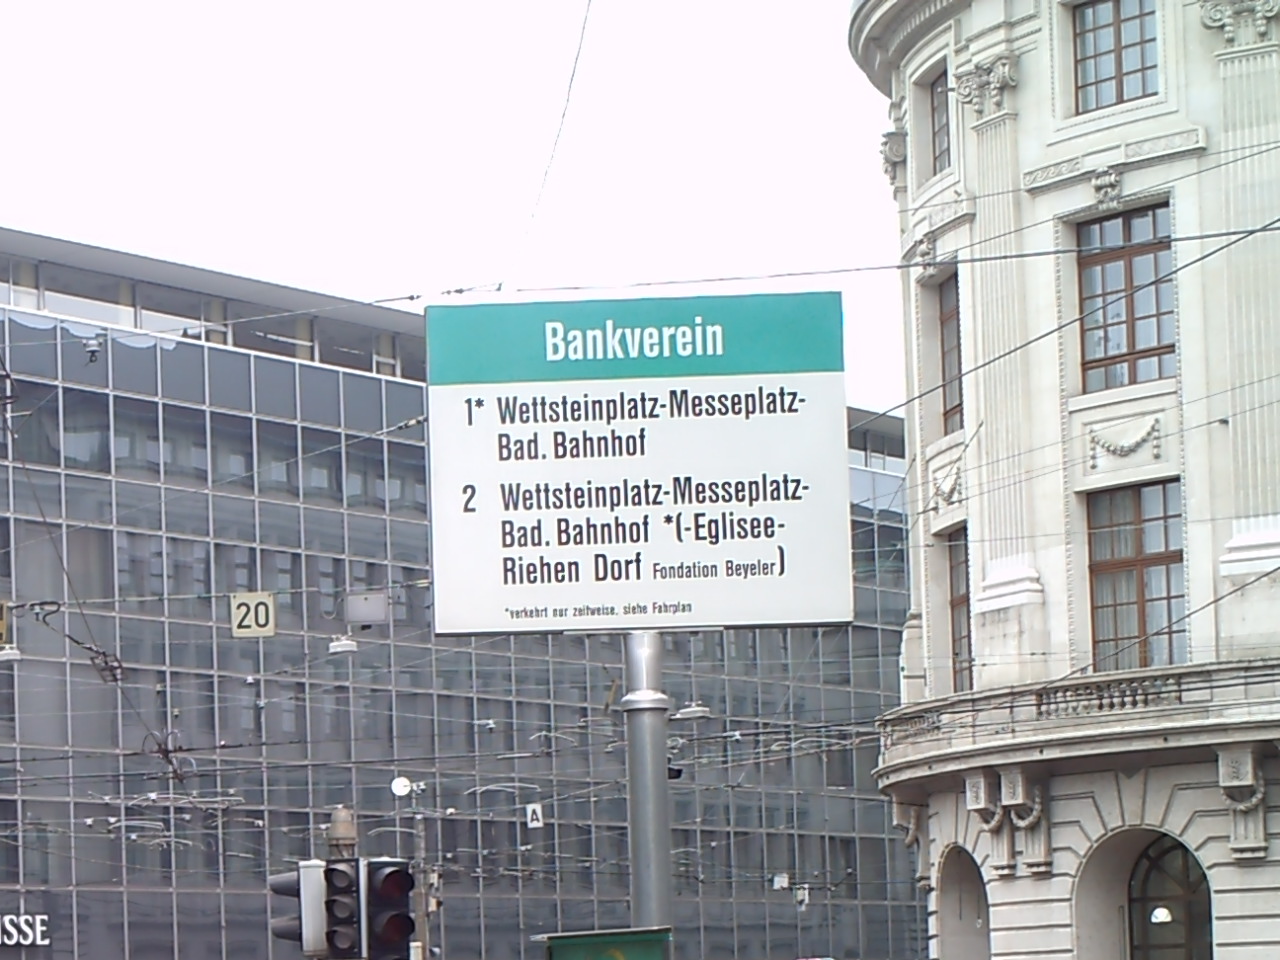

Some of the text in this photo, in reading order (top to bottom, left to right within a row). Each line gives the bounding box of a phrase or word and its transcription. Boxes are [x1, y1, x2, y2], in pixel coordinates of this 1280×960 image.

[544, 316, 724, 362] Bankverein
[496, 386, 807, 426] Wettsteinplatz-Messeplatz-
[498, 427, 647, 462] Bad. Bahnhof
[462, 473, 810, 513] 2 Wettsteinplatz-Messeplatz-
[501, 518, 551, 549] Bad.
[557, 514, 650, 546] Bahnhof
[503, 545, 786, 585] Riehen Dorf Fondation Beyeler)
[235, 601, 270, 630] 20
[622, 602, 648, 615] siehe
[652, 601, 693, 616] Fahrplan
[530, 807, 541, 824] A
